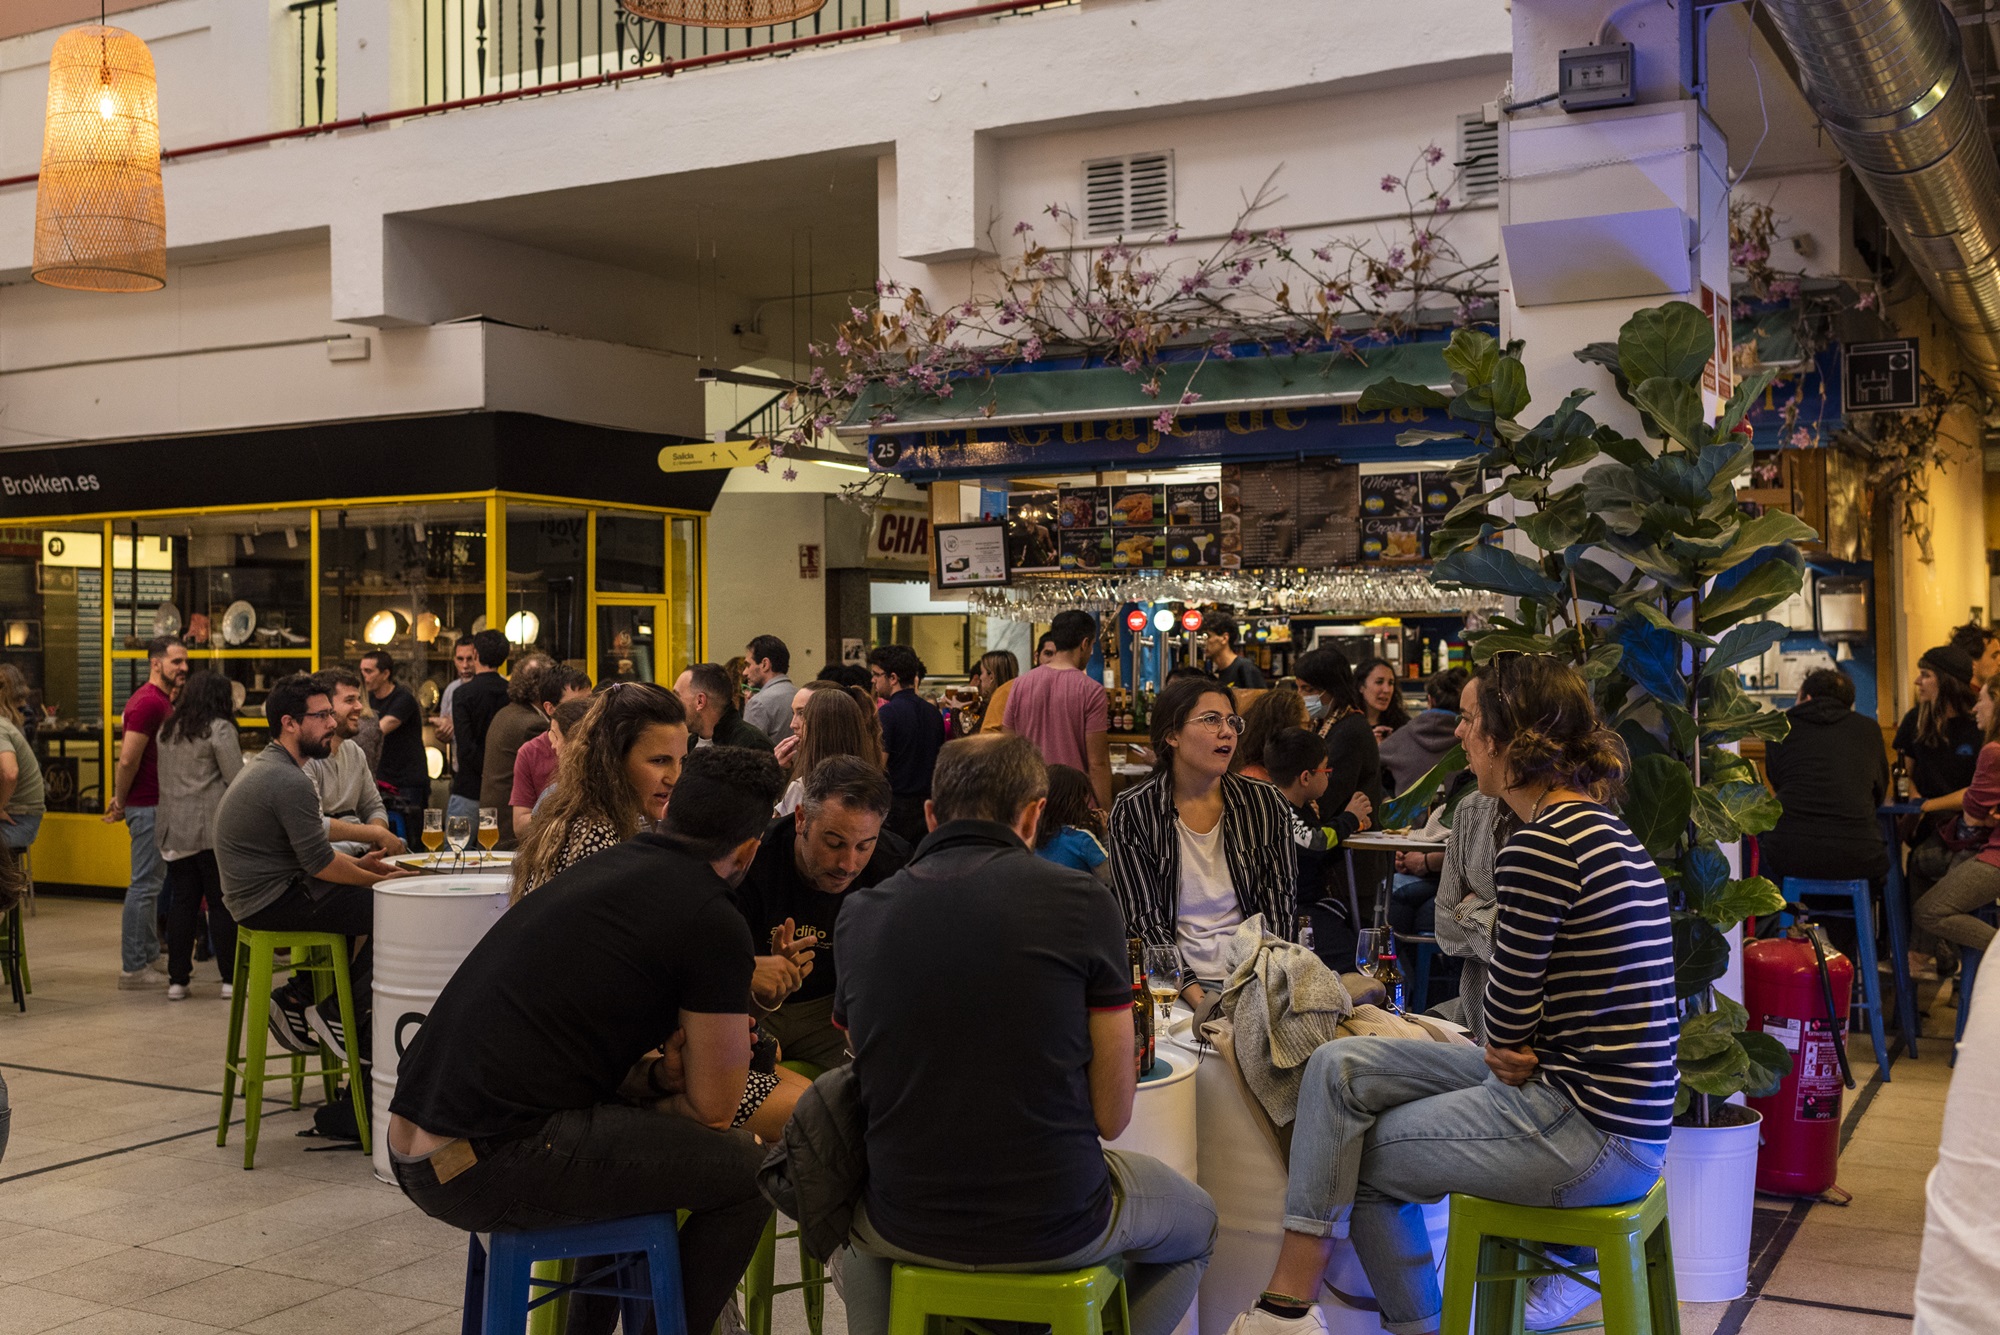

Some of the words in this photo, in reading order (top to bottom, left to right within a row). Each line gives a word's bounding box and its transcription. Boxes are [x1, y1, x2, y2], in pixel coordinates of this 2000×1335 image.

[672, 453, 694, 461] Salida
[877, 442, 896, 458] 25
[1, 474, 100, 495] Brokken.es
